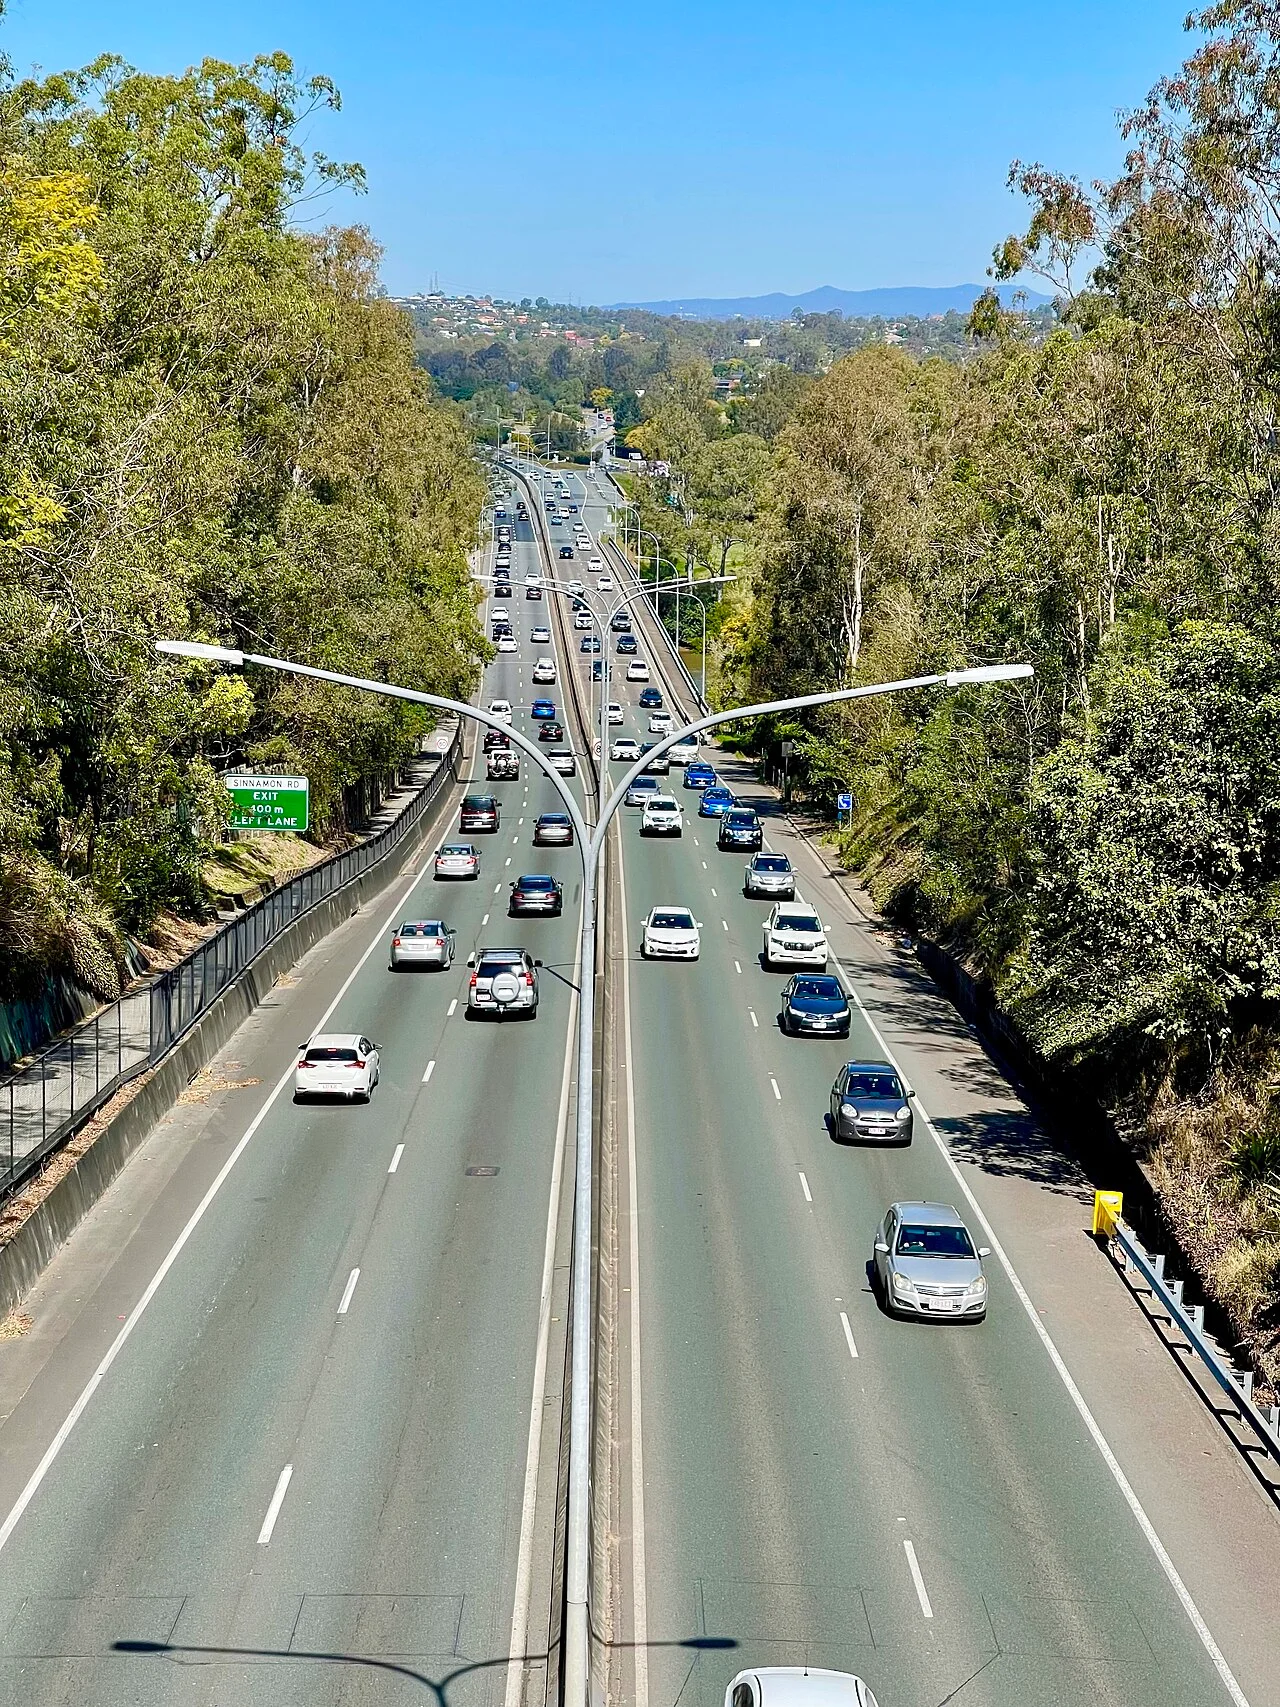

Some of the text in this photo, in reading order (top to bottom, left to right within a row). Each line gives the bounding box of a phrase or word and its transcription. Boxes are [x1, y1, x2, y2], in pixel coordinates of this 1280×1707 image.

[233, 779, 300, 788] SINNAMON RD
[253, 791, 279, 801] EXIT
[274, 806, 284, 814] m
[233, 816, 298, 826] LEFT LANE
